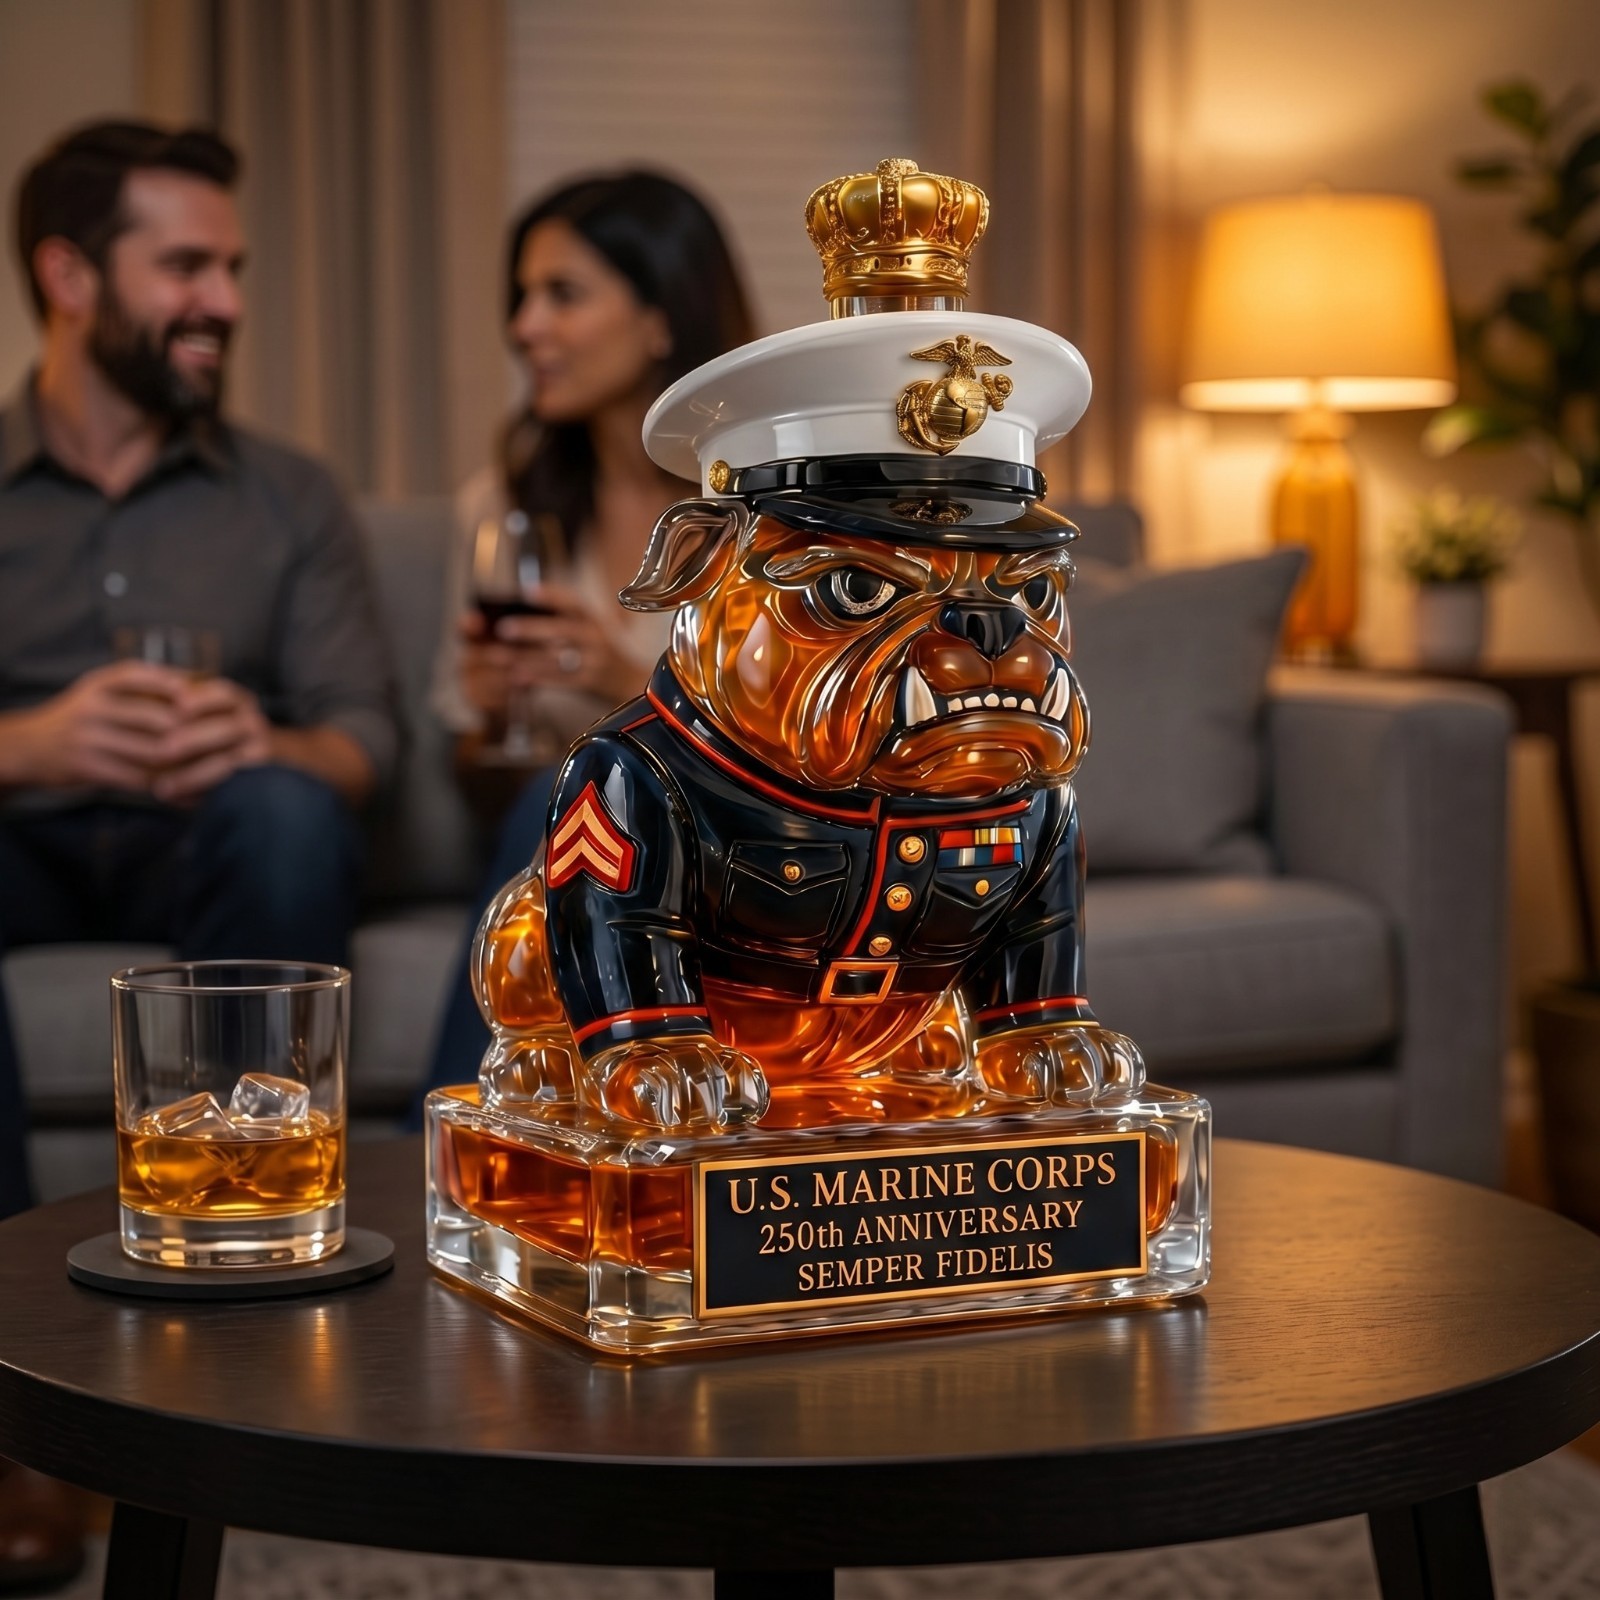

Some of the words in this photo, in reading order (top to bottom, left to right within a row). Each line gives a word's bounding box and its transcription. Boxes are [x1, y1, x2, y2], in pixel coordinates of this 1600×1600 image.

[728, 1176, 799, 1213] U.S.
[812, 1163, 974, 1206] MARINE
[988, 1153, 1115, 1192] CORPS
[759, 1221, 843, 1254] 250th
[853, 1200, 1083, 1245] ANNIVERSARY
[799, 1254, 924, 1291] SEMPER
[937, 1243, 1052, 1278] FIDELIS
